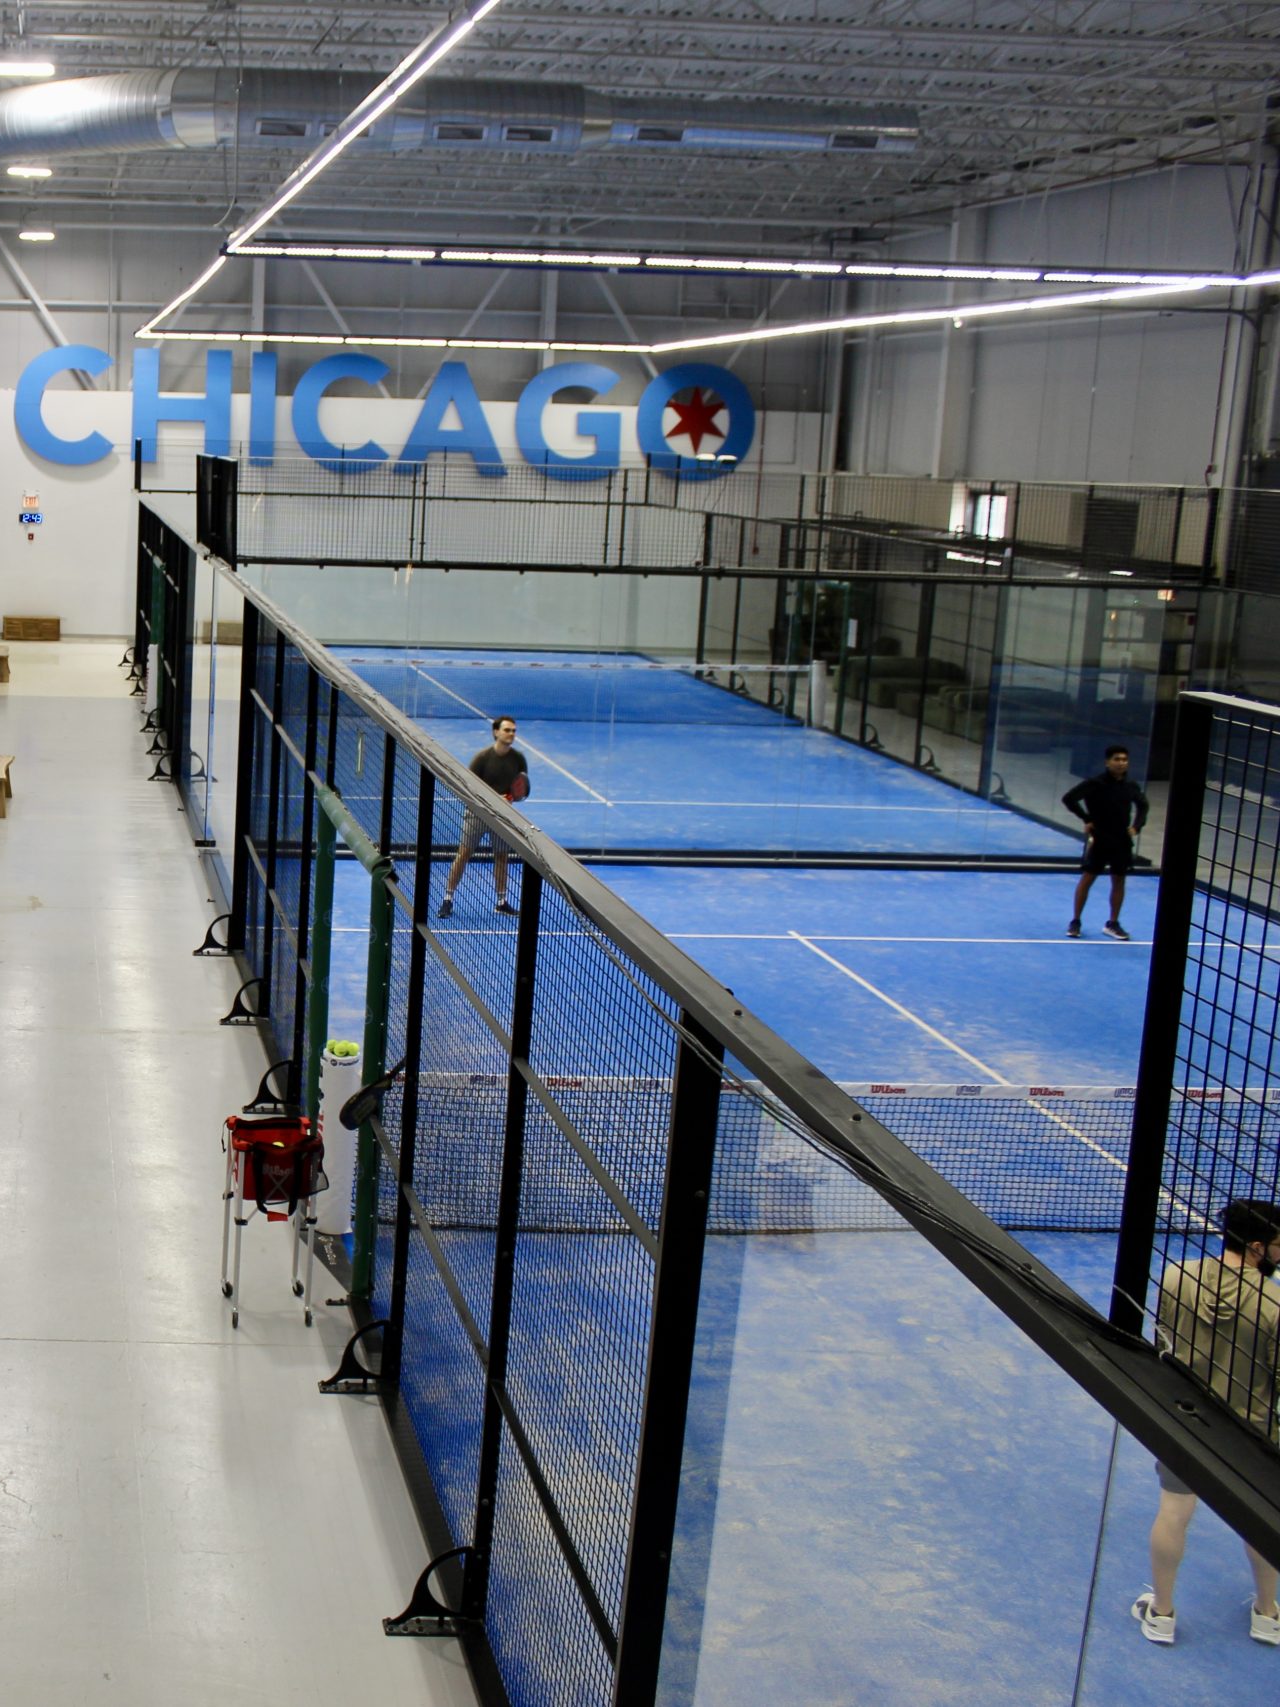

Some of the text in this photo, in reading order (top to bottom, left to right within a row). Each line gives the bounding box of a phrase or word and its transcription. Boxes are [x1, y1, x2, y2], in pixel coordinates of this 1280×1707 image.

[14, 344, 756, 482] CHICAGO
[871, 1084, 907, 1095] Wilson
[1029, 1087, 1065, 1097] Wilson
